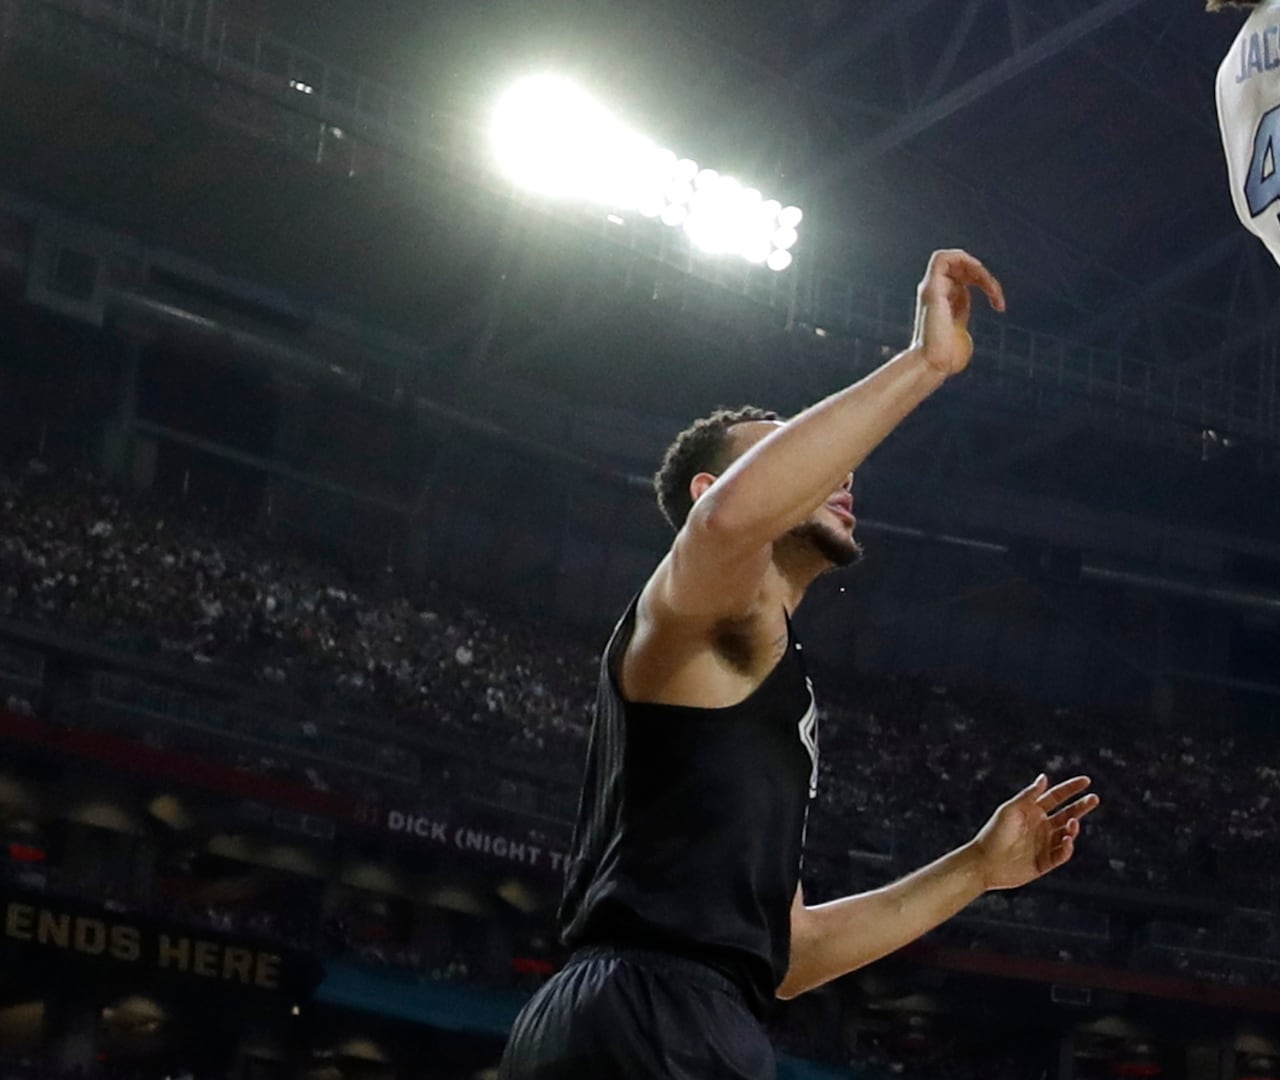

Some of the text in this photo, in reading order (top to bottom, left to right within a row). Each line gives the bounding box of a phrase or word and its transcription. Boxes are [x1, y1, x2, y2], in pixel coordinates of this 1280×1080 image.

[387, 809, 447, 844] DICK
[454, 827, 541, 865] (NIGHT
[4, 901, 281, 990] ENDS HERE
